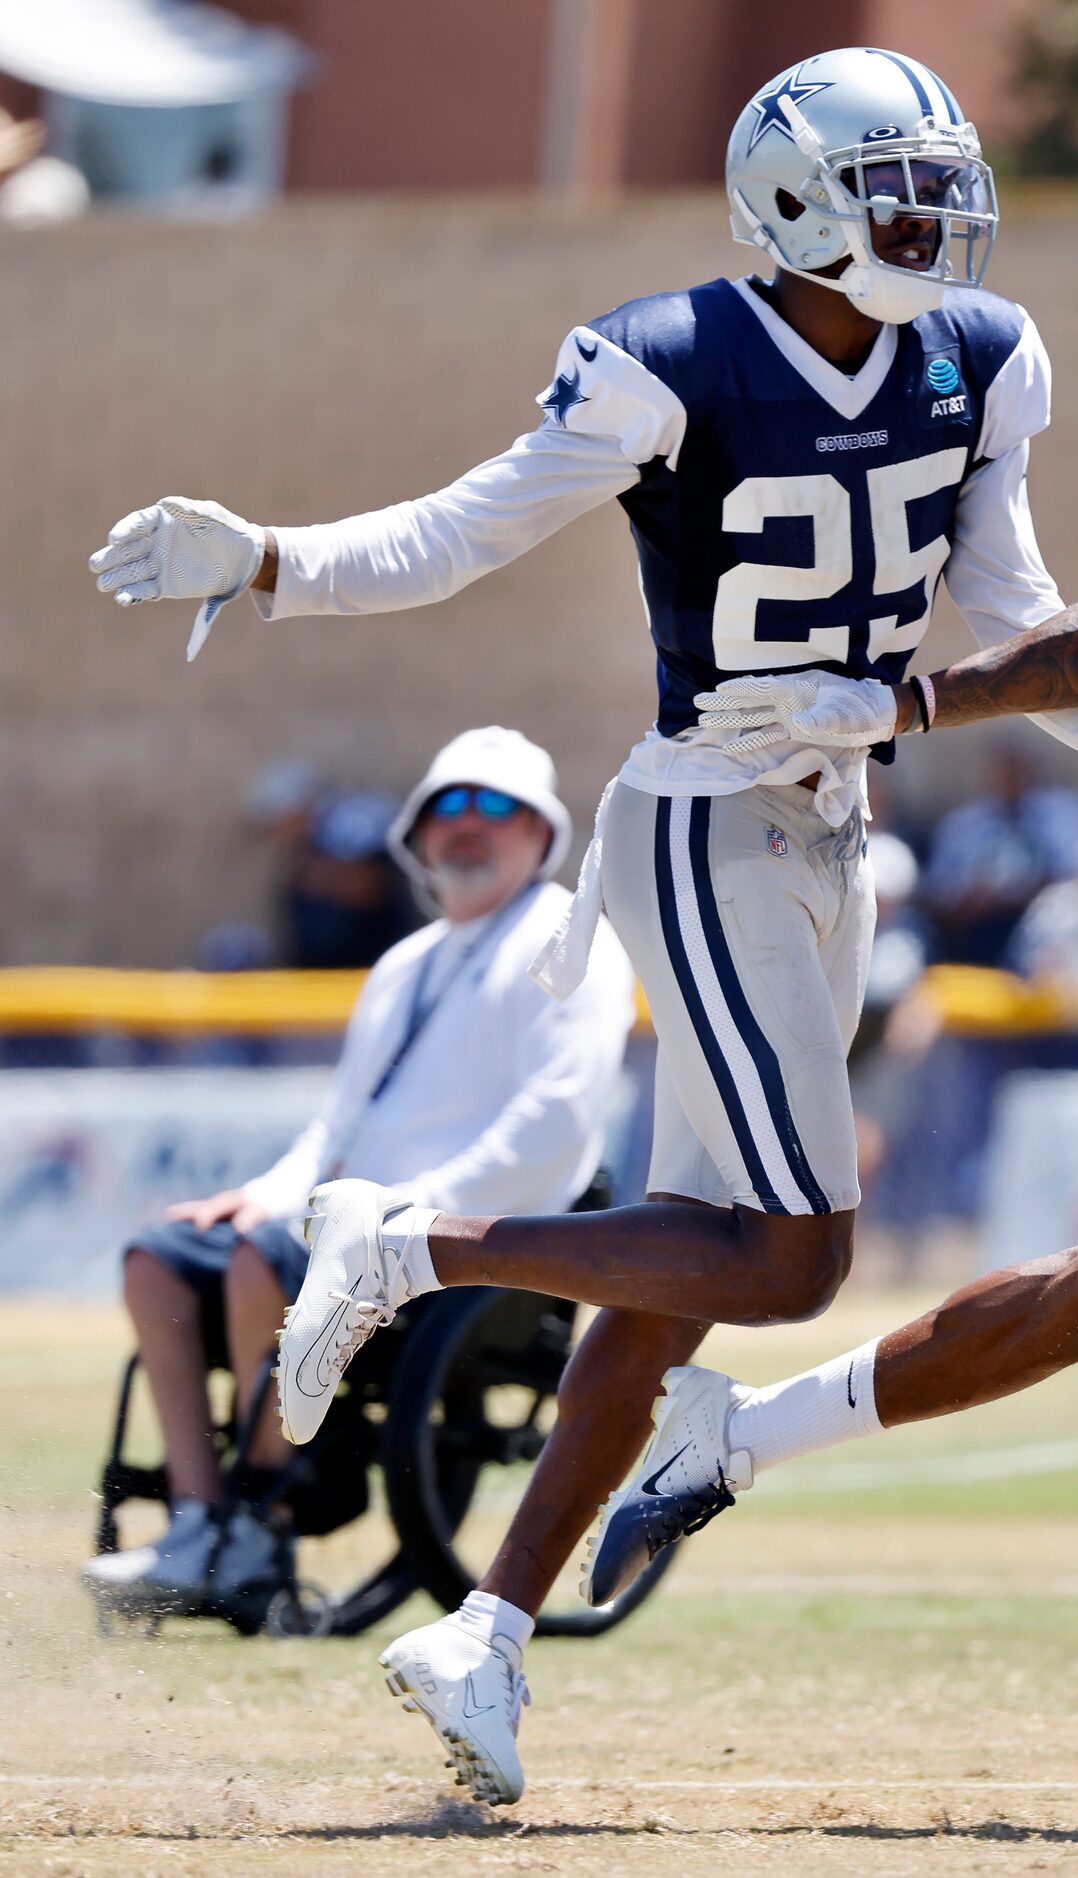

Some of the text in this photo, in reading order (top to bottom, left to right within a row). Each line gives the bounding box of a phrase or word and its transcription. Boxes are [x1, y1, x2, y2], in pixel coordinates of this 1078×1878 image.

[931, 395, 967, 418] AT&T
[815, 430, 889, 452] COWBOYS
[711, 447, 969, 671] 25
[770, 839, 786, 853] NFL
